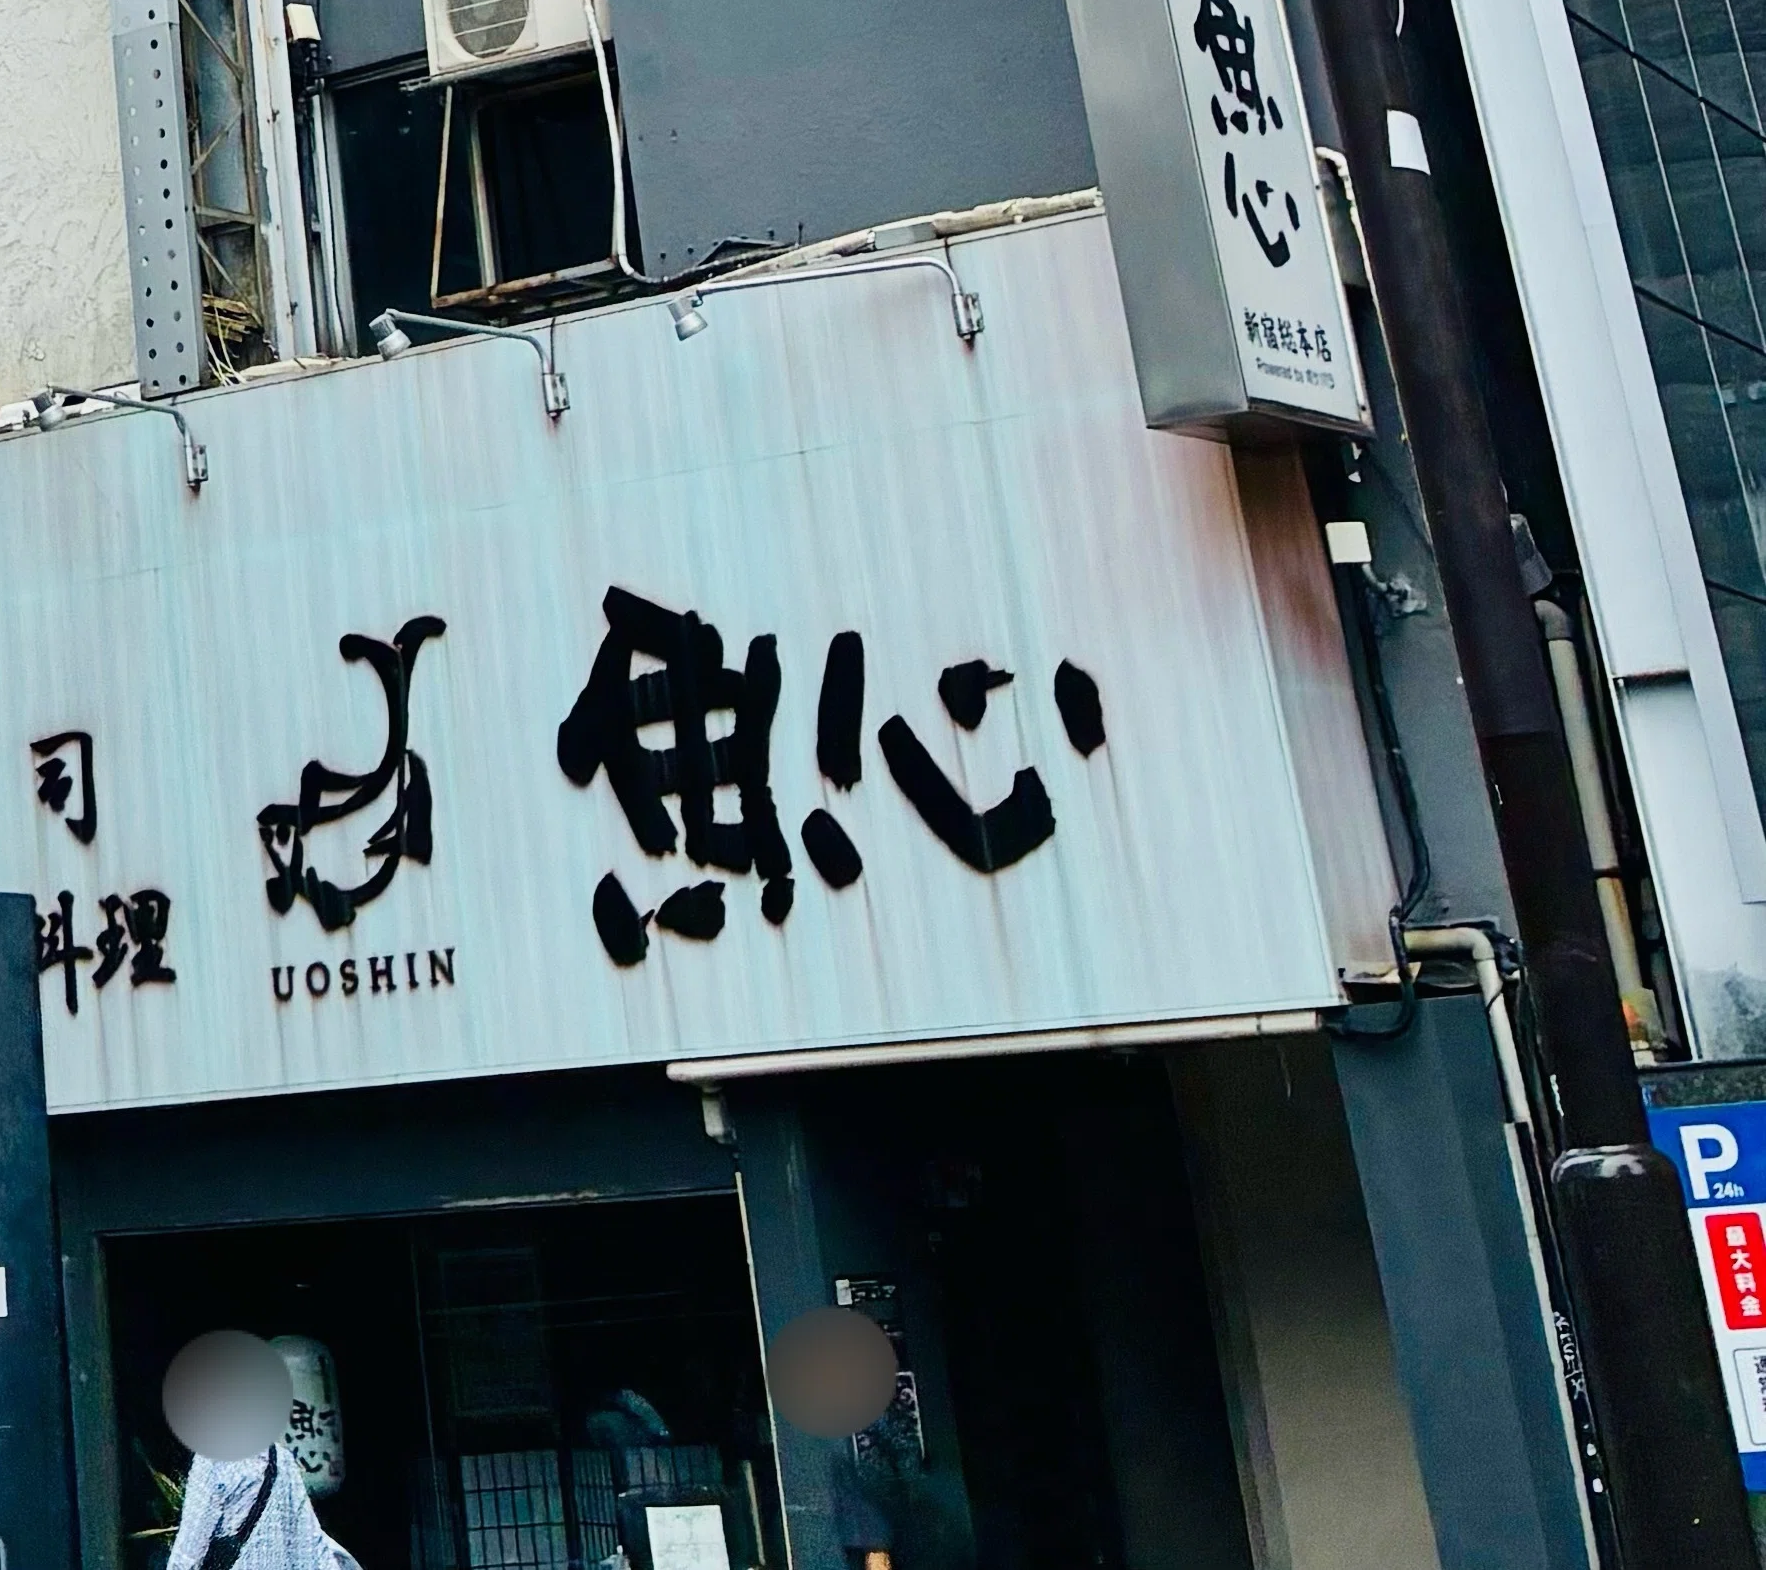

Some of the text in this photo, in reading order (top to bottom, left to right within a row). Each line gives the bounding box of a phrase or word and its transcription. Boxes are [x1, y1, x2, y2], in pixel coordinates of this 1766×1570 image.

[271, 946, 457, 1003] UOSHIN
[1679, 1123, 1738, 1200] P
[1712, 1182, 1745, 1200] 24h
[1725, 1224, 1763, 1317] 最大料金
